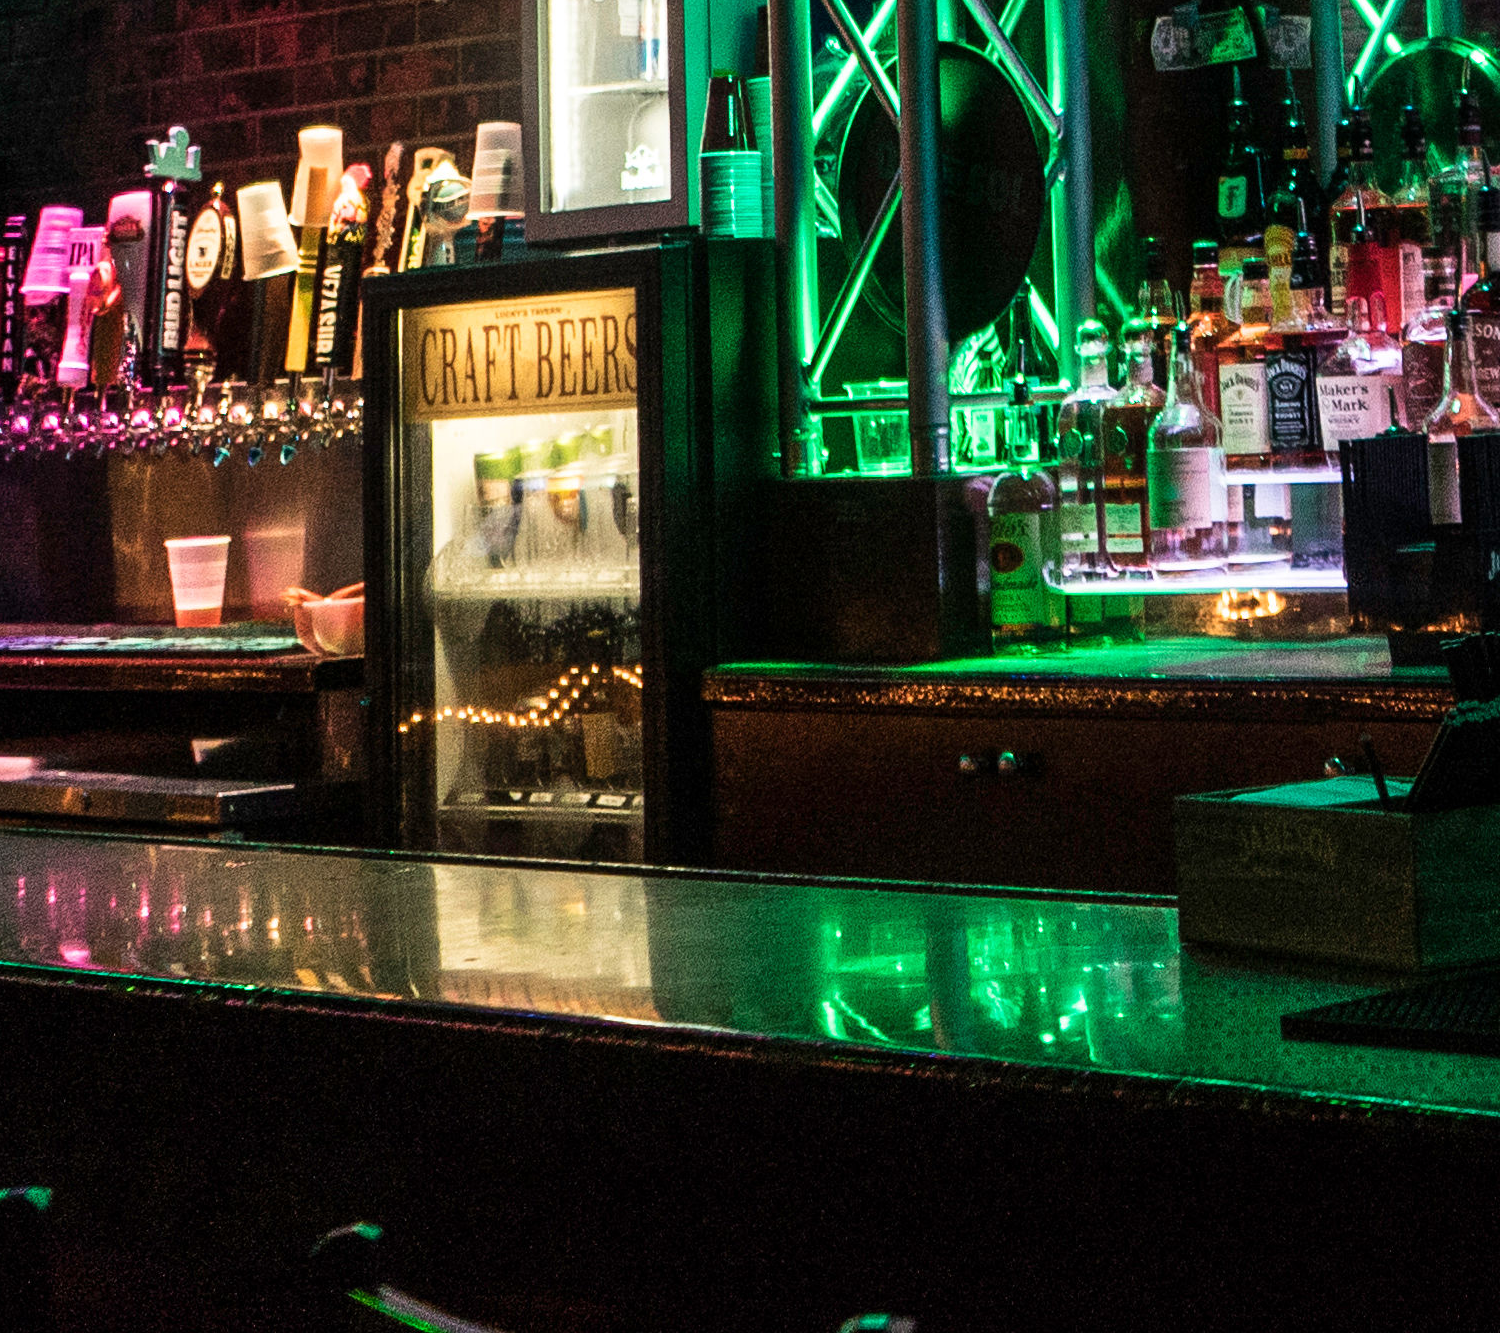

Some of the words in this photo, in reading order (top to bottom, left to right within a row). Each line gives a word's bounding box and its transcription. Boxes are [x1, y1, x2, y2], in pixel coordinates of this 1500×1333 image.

[70, 242, 96, 266] IPA
[165, 209, 189, 291] LIGHT
[2, 243, 17, 374] ELYSIAN
[420, 322, 522, 406] CRAFT
[534, 313, 637, 400] BEERS
[1319, 383, 1369, 398] Maker's
[1331, 397, 1370, 413] Mark
